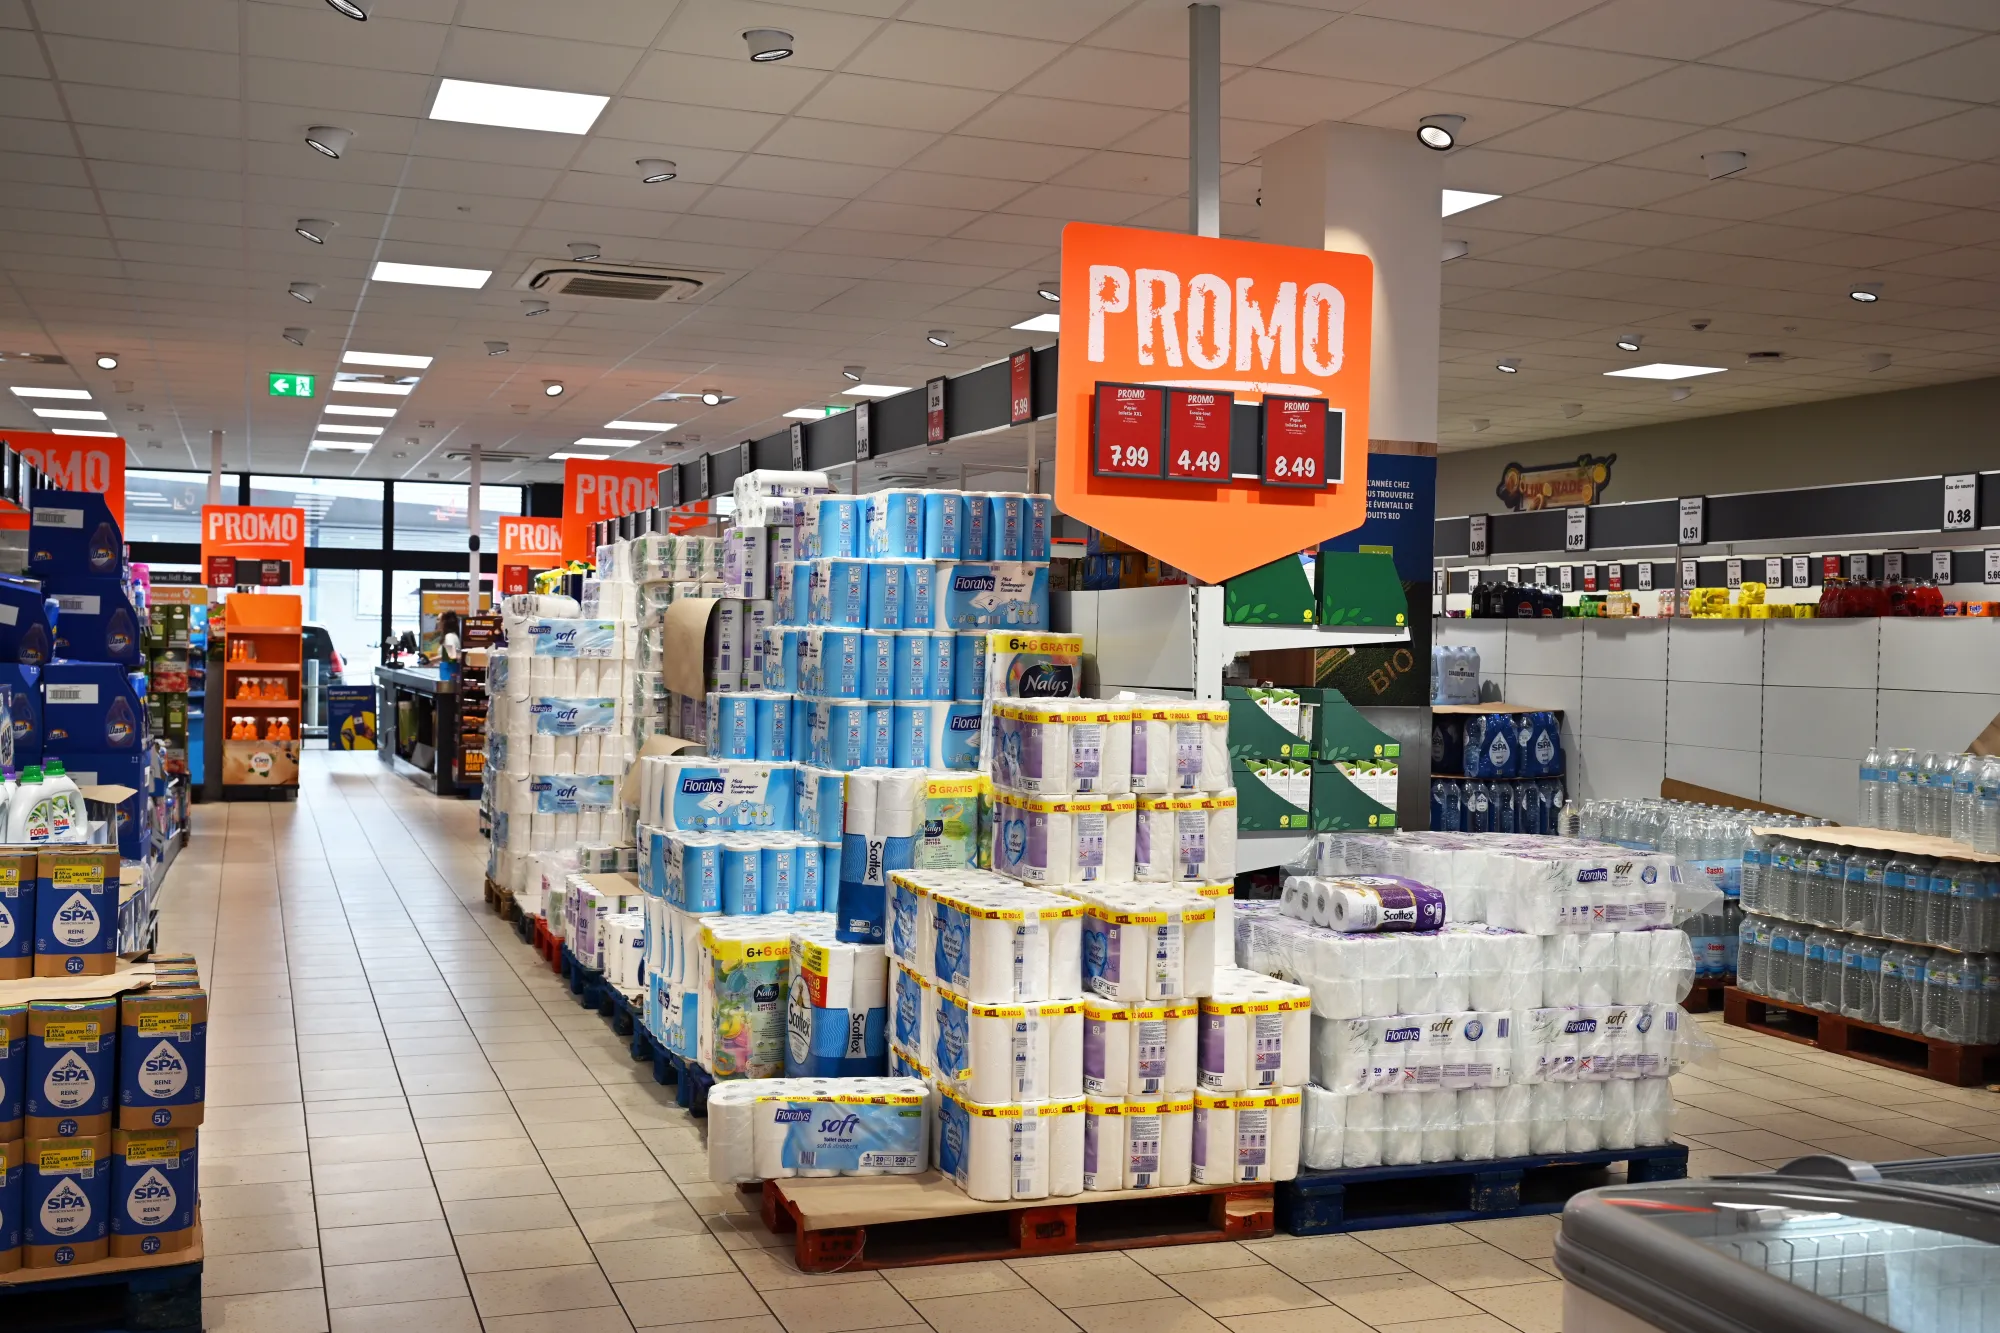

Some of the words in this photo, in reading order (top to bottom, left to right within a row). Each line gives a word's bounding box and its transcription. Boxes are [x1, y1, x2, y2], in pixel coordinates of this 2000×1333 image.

[1088, 264, 1346, 377] PROMO
[1117, 389, 1145, 399] PROMO
[1187, 394, 1214, 404] PROMO
[1014, 397, 1028, 416] 5.99
[1284, 401, 1310, 411] PROMO
[1110, 444, 1149, 468] 7.99
[1177, 449, 1221, 472] 4.49
[1274, 455, 1316, 477] 8.49
[1393, 481, 1410, 489] CHEZ
[1377, 490, 1414, 499] TROUVEREZ
[1373, 499, 1404, 509] ÉVENTAIL
[1405, 502, 1413, 510] DE
[1947, 509, 1971, 524] 0.38
[208, 512, 297, 541] PROMO
[505, 523, 562, 551] PROM
[1683, 527, 1698, 539] 0.51
[1471, 541, 1485, 551] 0.89
[1568, 534, 1583, 546] 0.87
[435, 581, 469, 589] www.lidl.
[954, 576, 994, 591] Floralys
[988, 598, 994, 606] 2
[555, 629, 577, 642] soft
[1009, 638, 1037, 651] 6+6
[1040, 642, 1080, 653] GRATIS
[1367, 648, 1413, 695] BIO
[1024, 674, 1069, 698] Nalys
[555, 707, 578, 720] soft
[109, 725, 126, 734] Dash
[1491, 742, 1507, 751] SPA
[1537, 742, 1552, 750] SPA
[555, 784, 578, 798] soft
[683, 777, 724, 793] Floralys
[938, 784, 973, 794] GRATIS
[717, 800, 723, 808] 2
[868, 841, 882, 882] Scottex
[1613, 861, 1633, 875] soft
[1578, 869, 1607, 881] Floralys
[59, 911, 95, 921] SPA
[1191, 913, 1206, 921] ROLLS
[1383, 909, 1414, 921] Scottex
[746, 946, 772, 957] 6+6
[67, 960, 80, 971] 5L
[755, 988, 778, 999] Nalys
[789, 1003, 811, 1038] Scottex
[1137, 1011, 1153, 1019] ROLLS
[1605, 1010, 1628, 1025] soft
[1429, 1017, 1454, 1032] soft
[1565, 1021, 1597, 1034] Floralys
[850, 1013, 865, 1054] Scottex
[1386, 1028, 1420, 1042] Floralys
[145, 1059, 182, 1071] SPA
[52, 1070, 89, 1082] SPA
[901, 1096, 919, 1104] ROLLS
[154, 1114, 166, 1124] 5L
[776, 1109, 811, 1122] Floralys
[59, 1124, 71, 1134] 5L
[817, 1113, 860, 1137] soft
[134, 1187, 170, 1198] SPA
[47, 1197, 85, 1209] SPA
[143, 1241, 155, 1250] 5L
[56, 1252, 69, 1262] 5L
